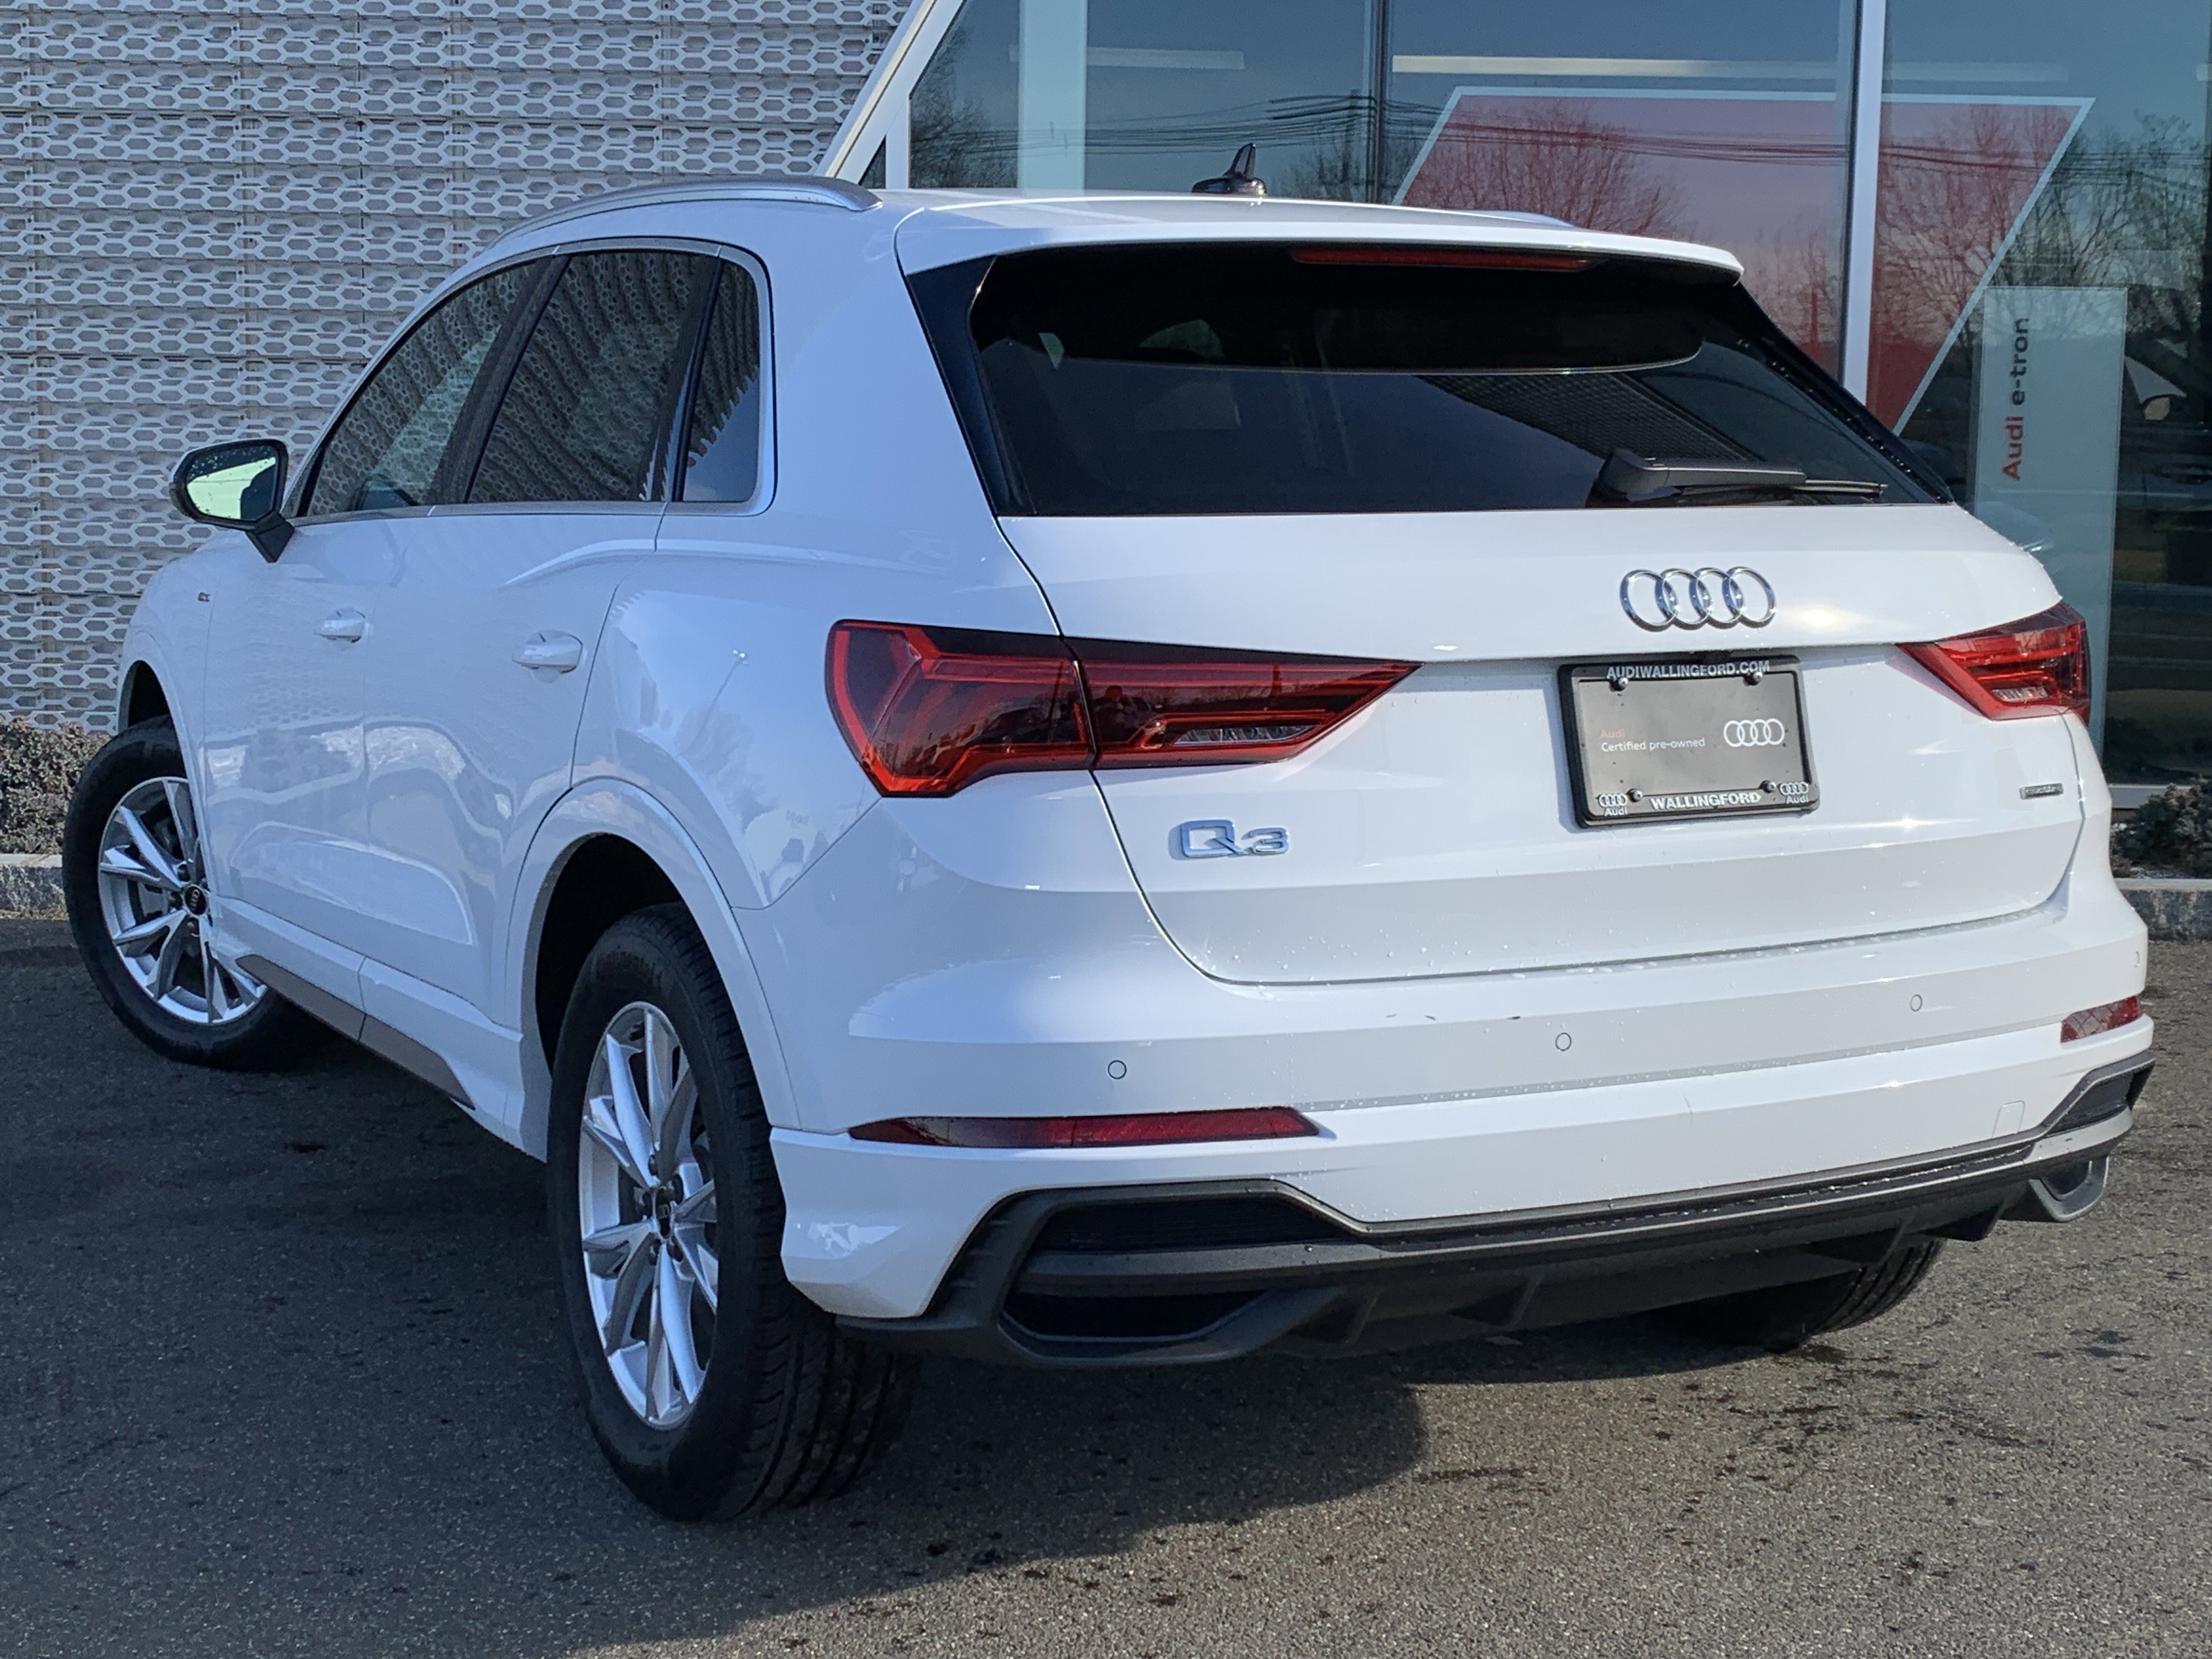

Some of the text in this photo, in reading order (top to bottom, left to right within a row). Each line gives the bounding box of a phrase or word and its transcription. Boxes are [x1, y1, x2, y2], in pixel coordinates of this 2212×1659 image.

[2002, 317, 2029, 481] Audi e-tron
[1606, 660, 1770, 679] AUDIWALLINGFORD.COM
[1600, 729, 1625, 738] Audi
[1601, 737, 1705, 752] Certified pre-owned
[1649, 792, 1761, 810] WALLINGFORD
[1786, 795, 1809, 804] Audi
[1604, 806, 1628, 816] Audi
[1180, 819, 1289, 858] Q3
